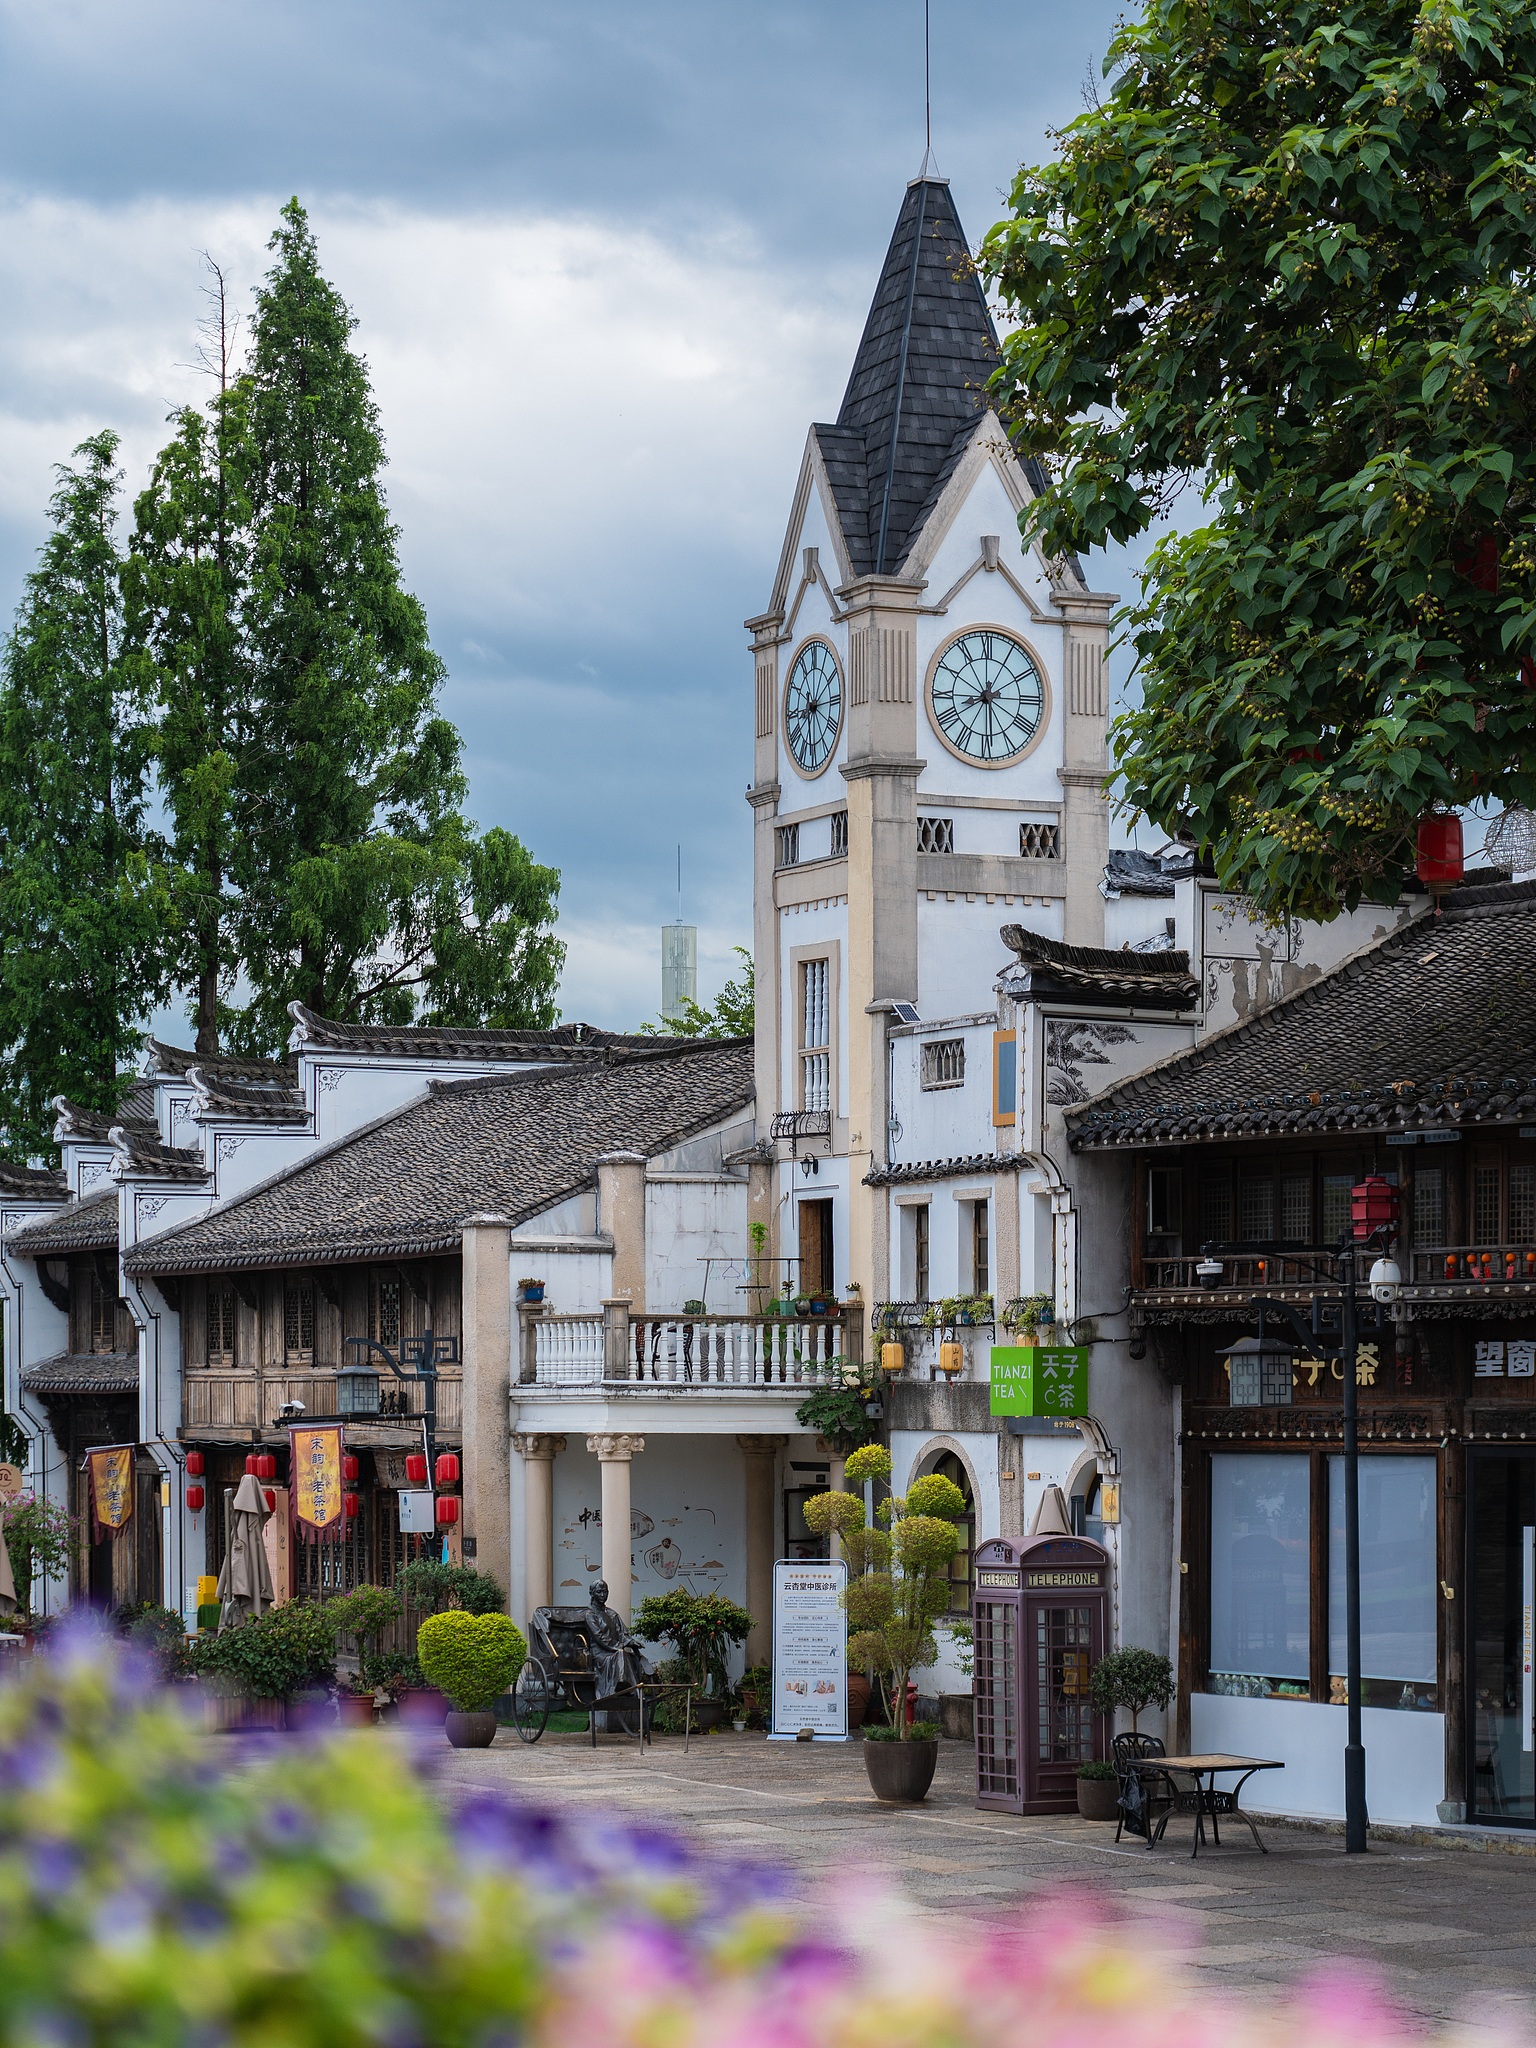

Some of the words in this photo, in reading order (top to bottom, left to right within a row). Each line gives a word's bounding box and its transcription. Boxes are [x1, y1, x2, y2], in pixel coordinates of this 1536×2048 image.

[1475, 1340, 1536, 1377] 望窗
[993, 1365, 1031, 1379] TIANZI
[1042, 1354, 1079, 1379] 天子
[993, 1384, 1015, 1398] TEA
[784, 1582, 837, 1591] 云杏堂中医诊所
[981, 1573, 1019, 1586] TELEPHONE
[1030, 1573, 1096, 1586] TELEPHONE
